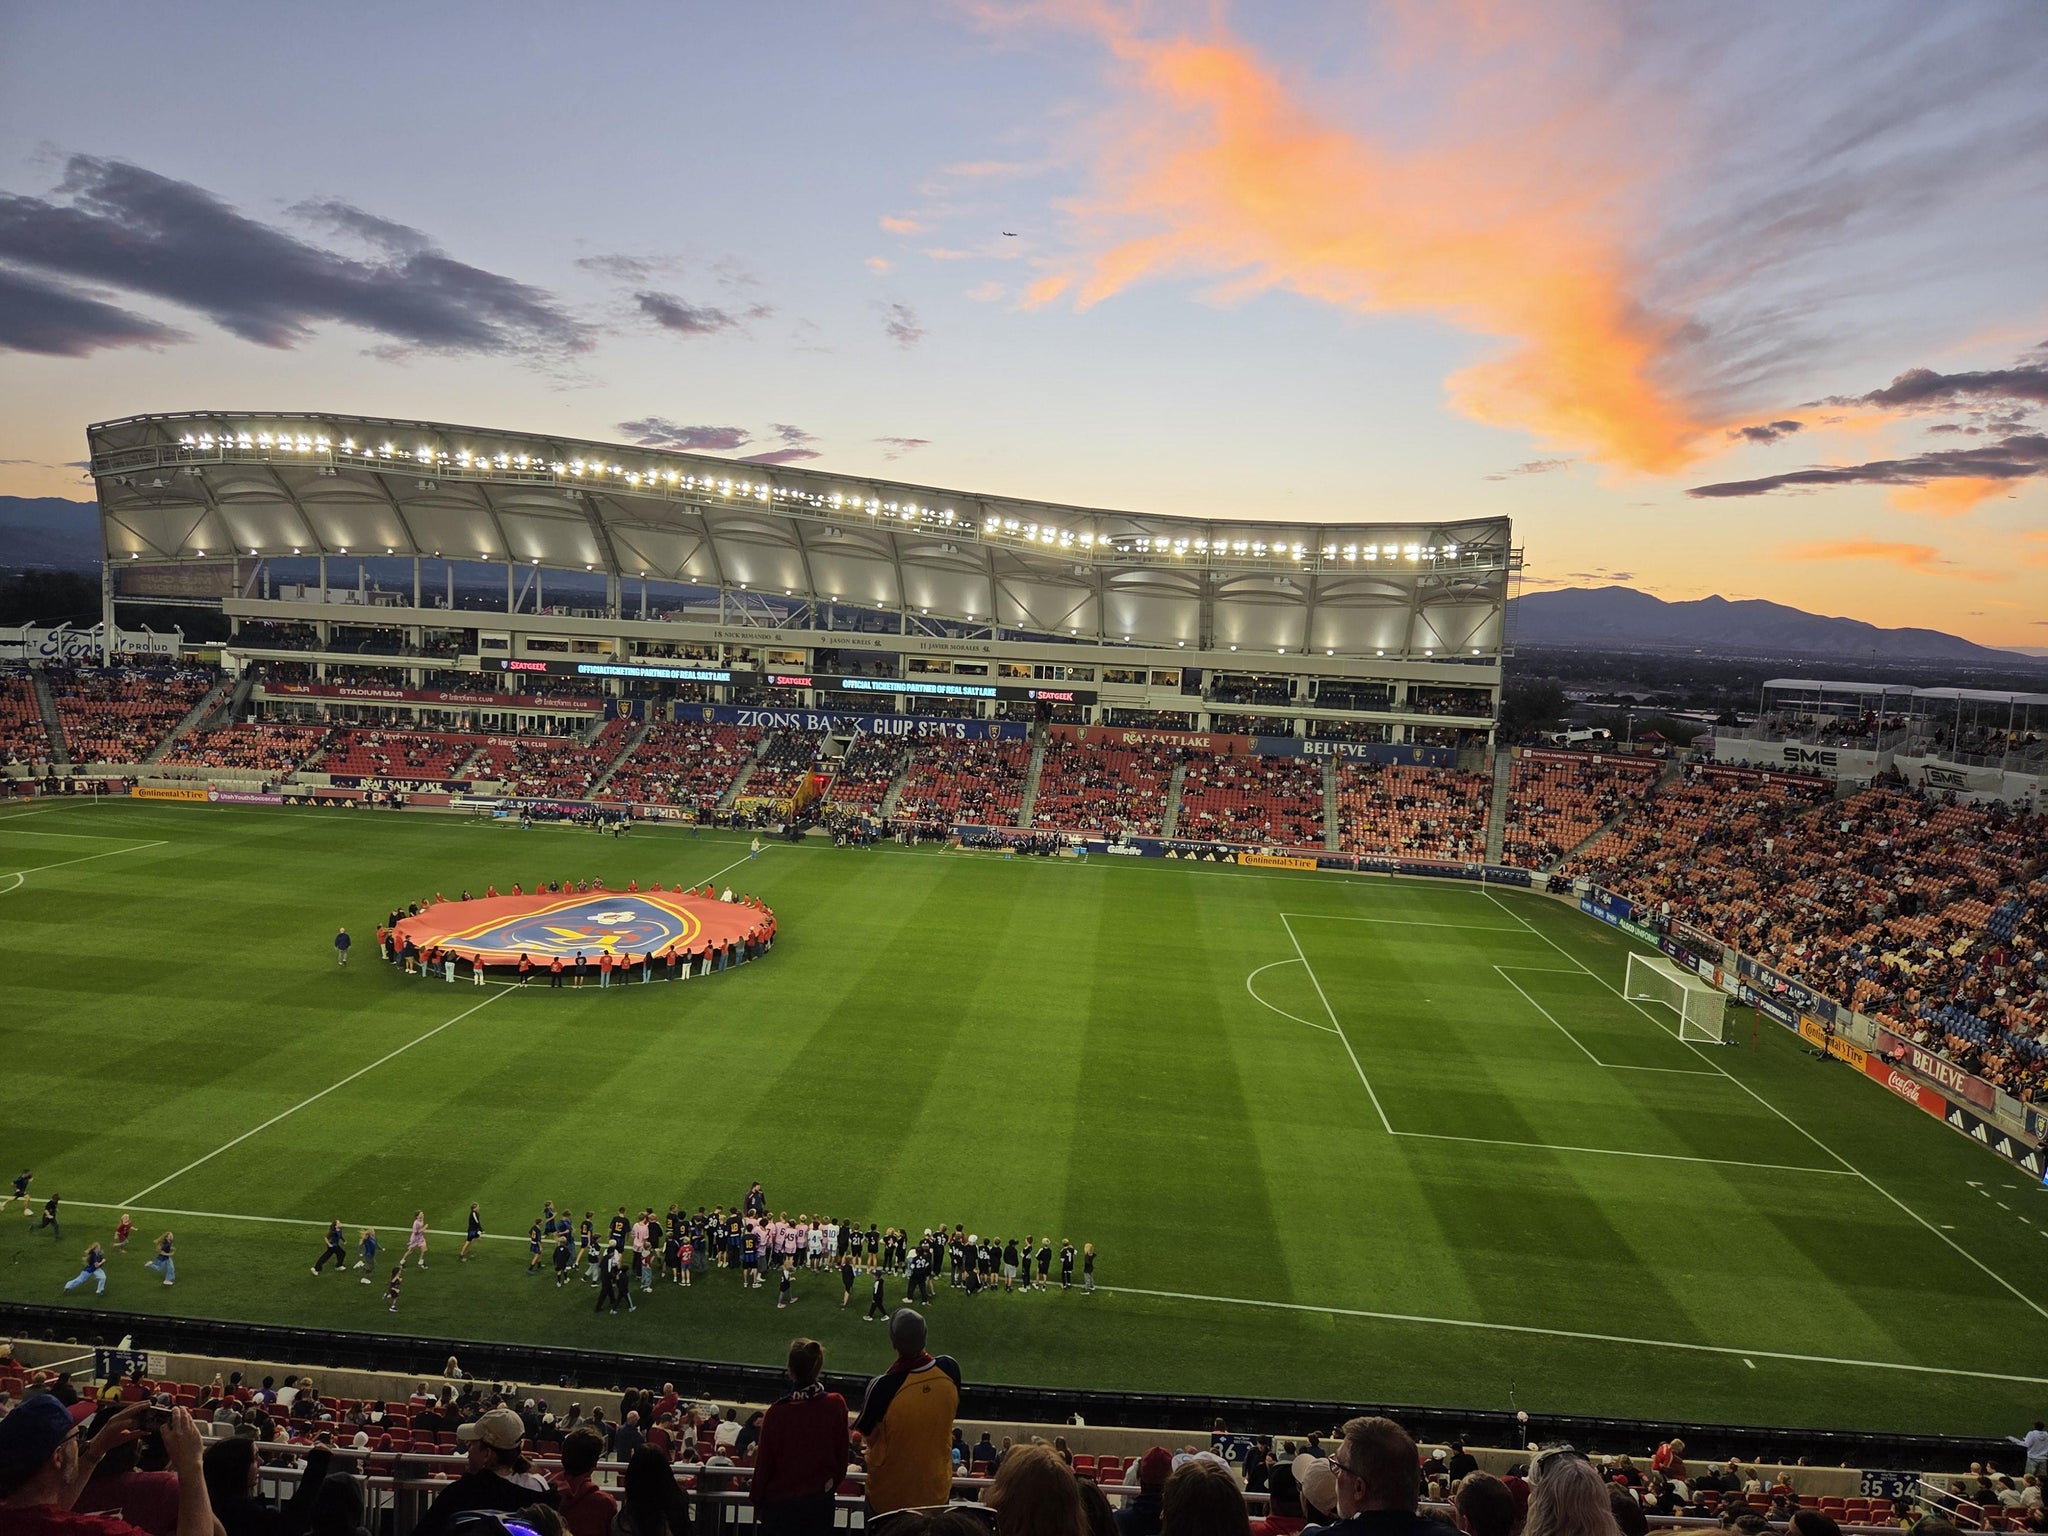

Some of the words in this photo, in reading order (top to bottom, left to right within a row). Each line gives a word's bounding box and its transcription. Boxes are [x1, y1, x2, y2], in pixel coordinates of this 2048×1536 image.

[950, 644, 980, 652] MORALES
[510, 662, 547, 671] SEATGEEK
[605, 666, 640, 676] TICKETING
[640, 668, 670, 678] PARTNER
[671, 670, 680, 678] OF
[680, 671, 696, 680] REAL
[696, 672, 713, 680] SALT
[713, 673, 731, 681] LAKE
[777, 676, 812, 686] SEATGEEK
[340, 688, 382, 697] STADIUM
[842, 680, 871, 689] OFFICIAL
[872, 681, 906, 691] TICKETING
[906, 683, 936, 693] PARTNER
[937, 685, 946, 693] OF
[946, 686, 962, 694] REAL
[962, 687, 979, 695] SALT
[980, 688, 997, 697] LAKE
[1038, 691, 1073, 701] SEATGEEK
[736, 710, 801, 729] ZIONS
[1181, 737, 1211, 748] LAKE
[1303, 741, 1367, 758] BELIEVE
[1783, 747, 1838, 767] SME
[1787, 778, 1803, 786] FAMILY
[1931, 770, 1964, 788] SME
[138, 790, 180, 798] Continental
[185, 791, 203, 799] Tire
[1107, 845, 1143, 856] Gillette
[1244, 854, 1287, 866] Continental
[1292, 858, 1312, 868] Tire
[1634, 926, 1660, 945] UNIFORMS
[1846, 1046, 1863, 1064] Tire
[1912, 1050, 1965, 1093] BELIEVE
[615, 1222, 624, 1232] 12
[811, 1235, 817, 1243] 4
[125, 1360, 147, 1376] 37
[1213, 1443, 1237, 1460] 36
[1860, 1480, 1883, 1497] 35
[1892, 1481, 1916, 1498] 34
